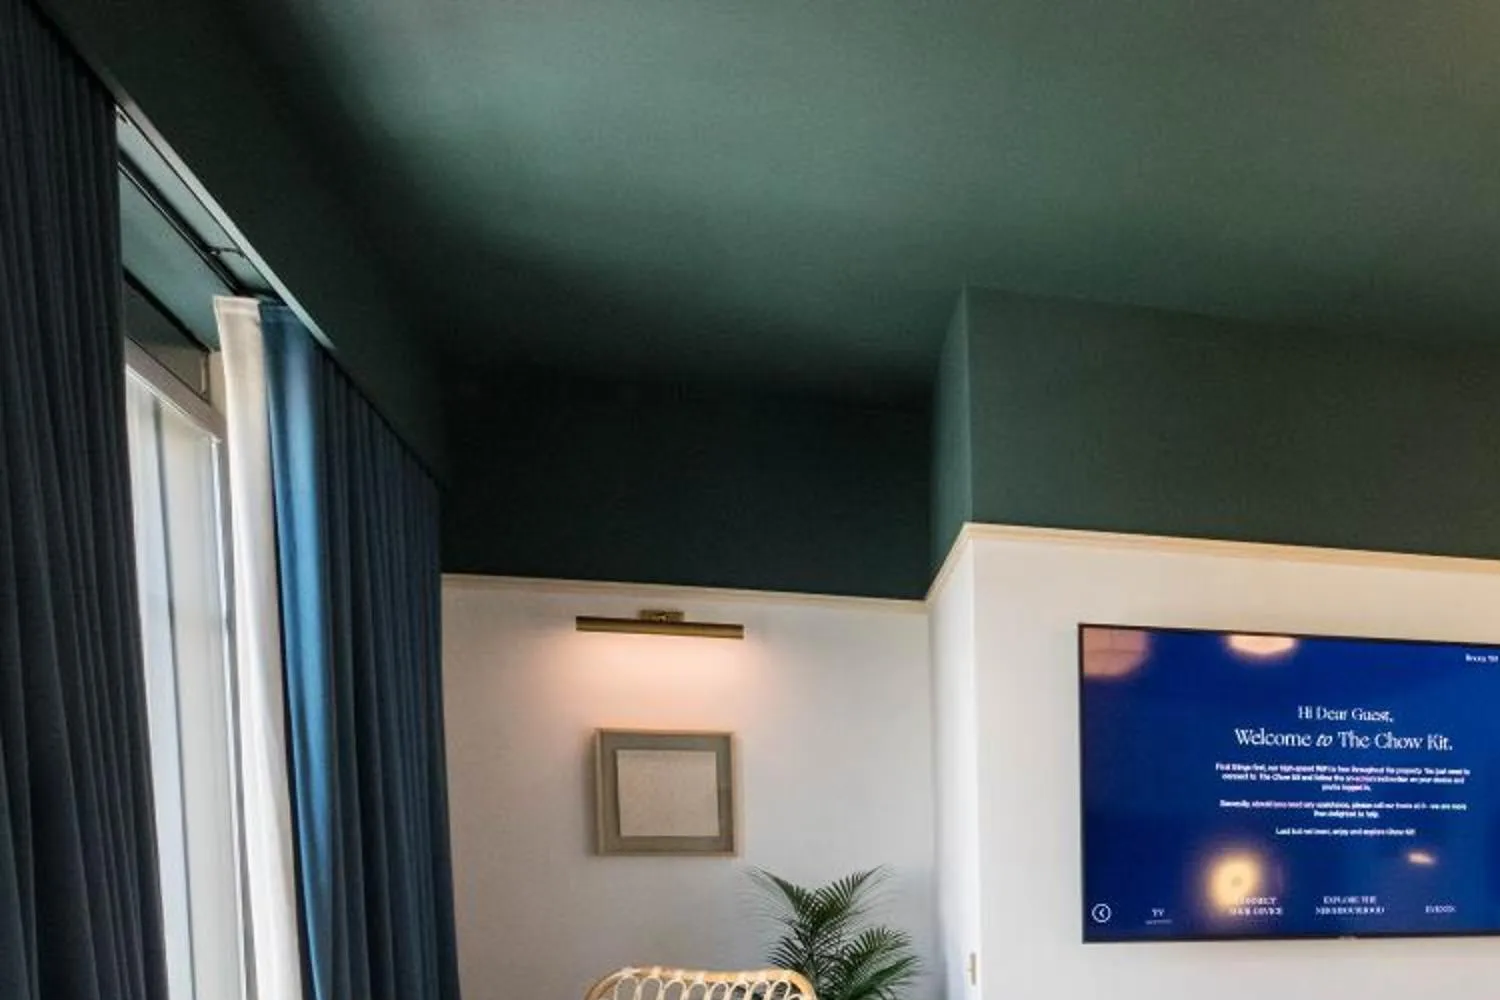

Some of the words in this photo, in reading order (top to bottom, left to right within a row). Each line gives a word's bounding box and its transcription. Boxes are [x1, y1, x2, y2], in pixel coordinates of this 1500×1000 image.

[1298, 705, 1313, 719] Hi
[1315, 706, 1347, 721] Dear
[1351, 708, 1394, 723] Guest,
[1234, 728, 1311, 747] Welcome
[1315, 733, 1333, 747] to
[1337, 730, 1370, 748] The
[1374, 731, 1423, 749] Chow
[1427, 733, 1453, 750] Kit.
